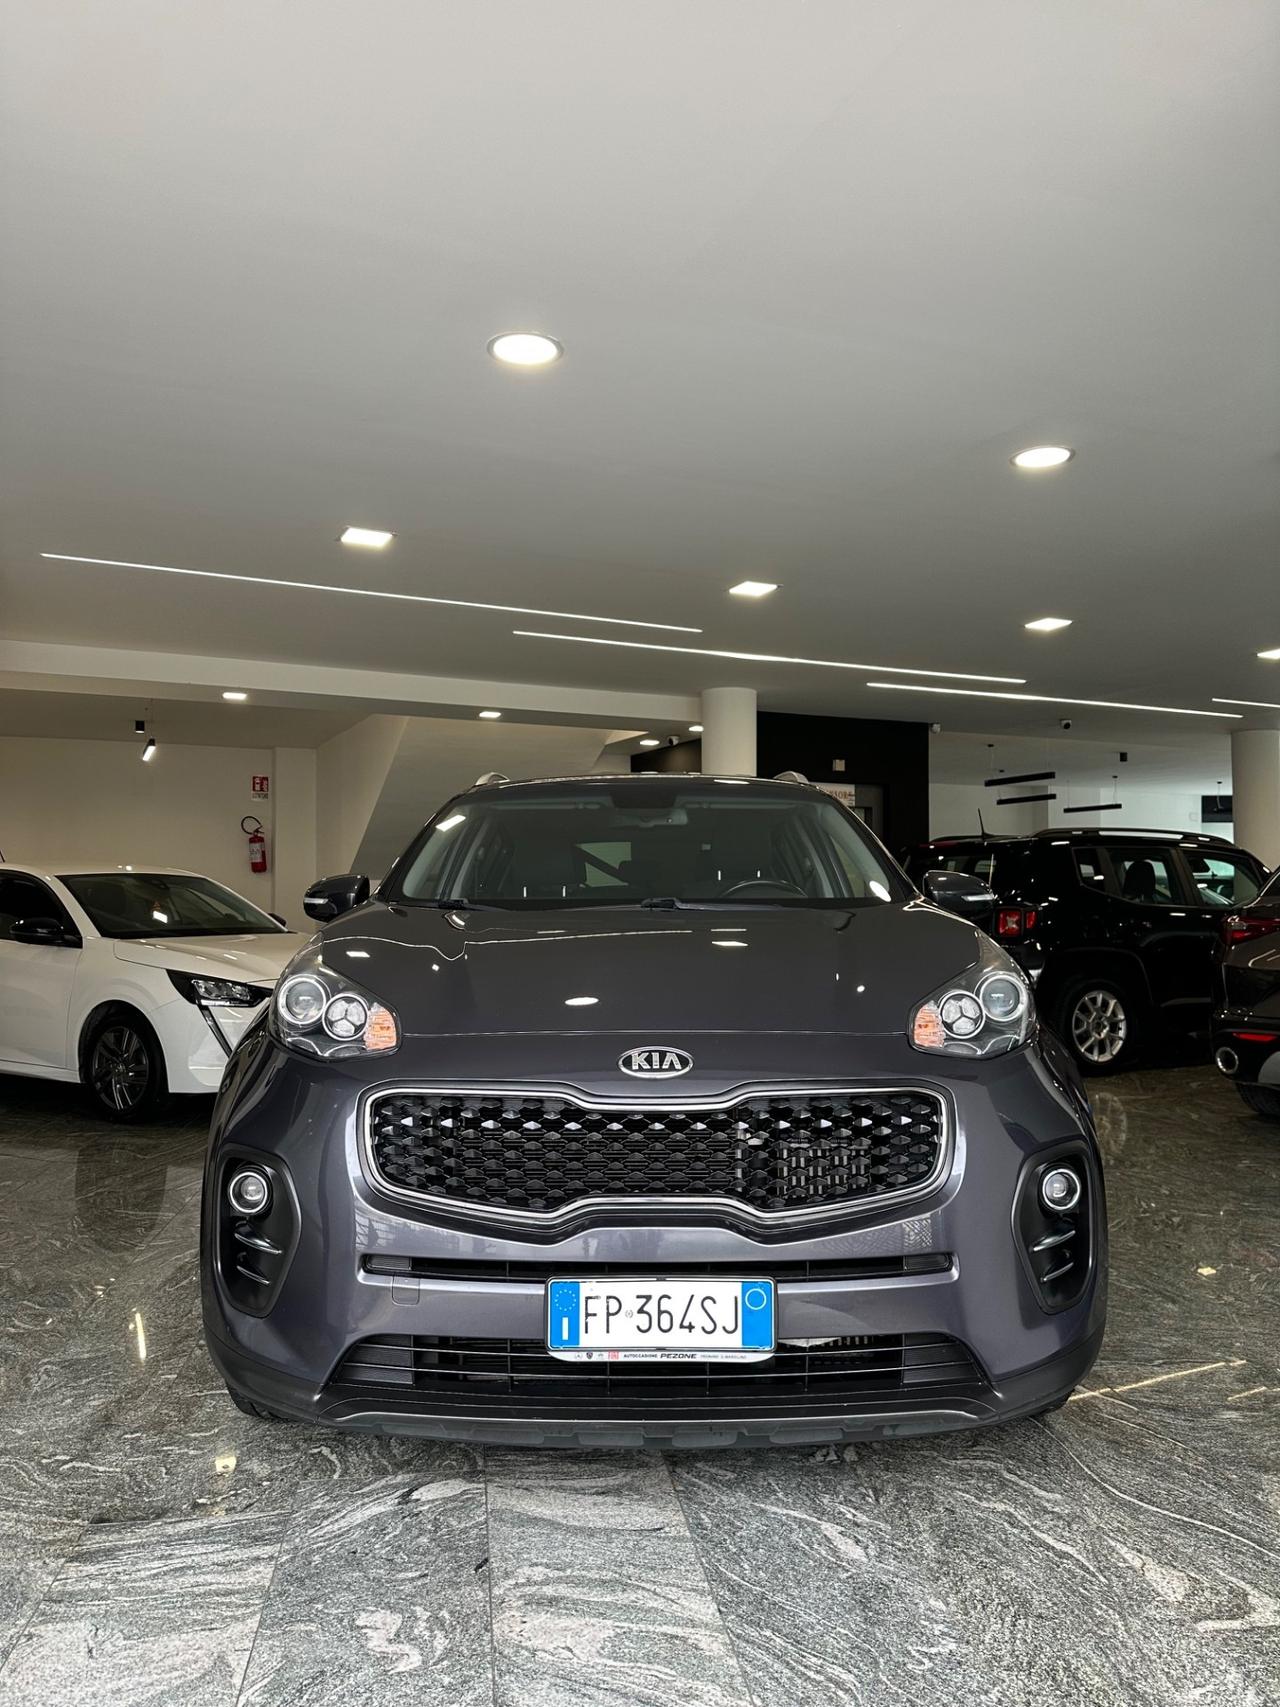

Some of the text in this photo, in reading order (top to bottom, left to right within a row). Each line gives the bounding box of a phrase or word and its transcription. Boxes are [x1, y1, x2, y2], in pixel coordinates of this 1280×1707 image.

[631, 1052, 682, 1070] KIA
[584, 1294, 738, 1335] FP 364SJ
[660, 1352, 697, 1360] PEZONE
